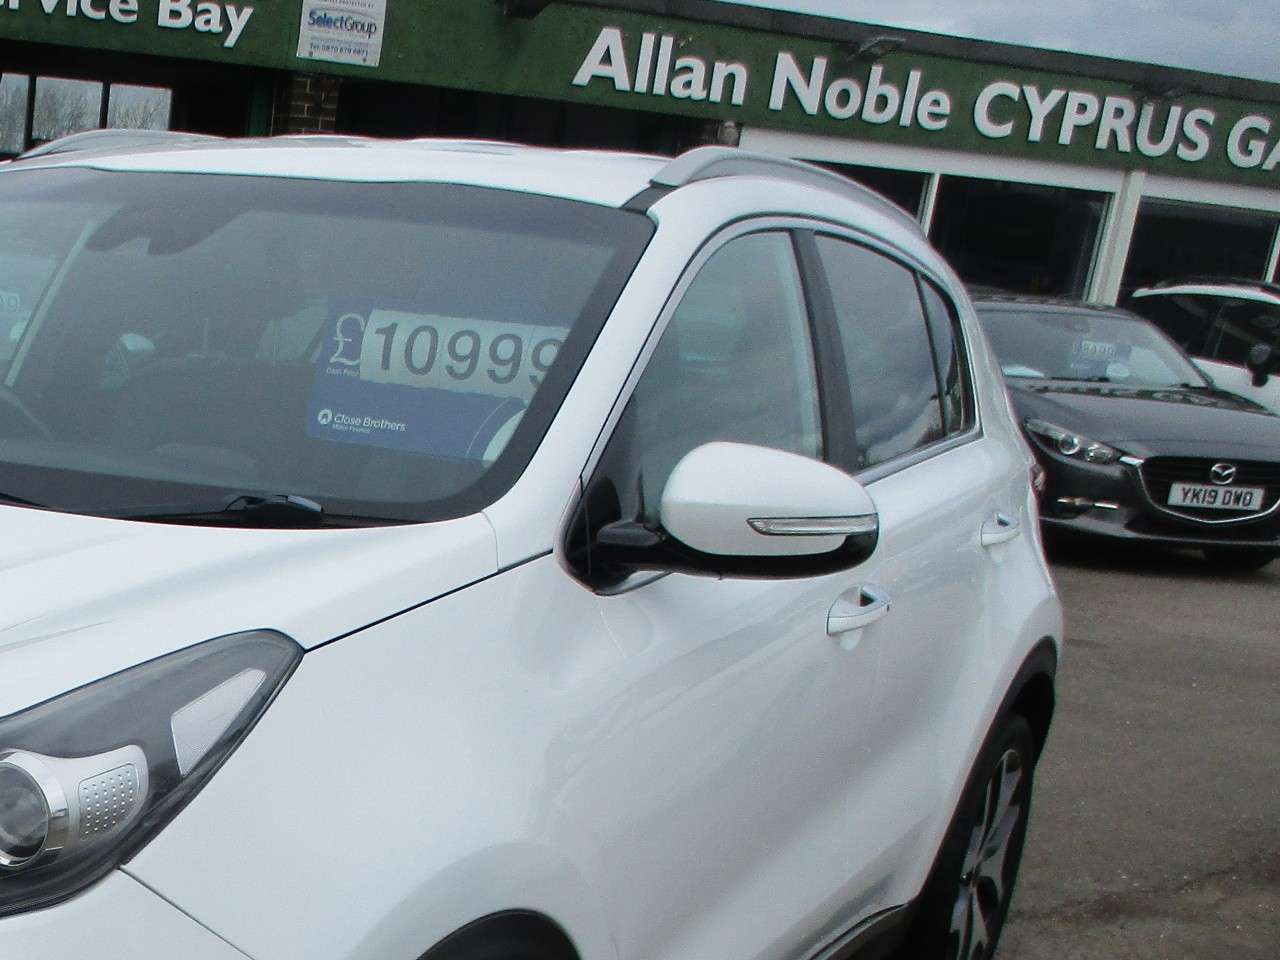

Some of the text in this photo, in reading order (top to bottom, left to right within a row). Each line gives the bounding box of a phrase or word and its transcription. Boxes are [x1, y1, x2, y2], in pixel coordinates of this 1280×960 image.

[157, 0, 254, 48] Bay
[572, 26, 747, 105] Allan
[768, 51, 950, 130] Noble
[973, 81, 1215, 162] CYPRUS
[334, 413, 407, 432] Close Brothers
[1181, 487, 1218, 505] YK19
